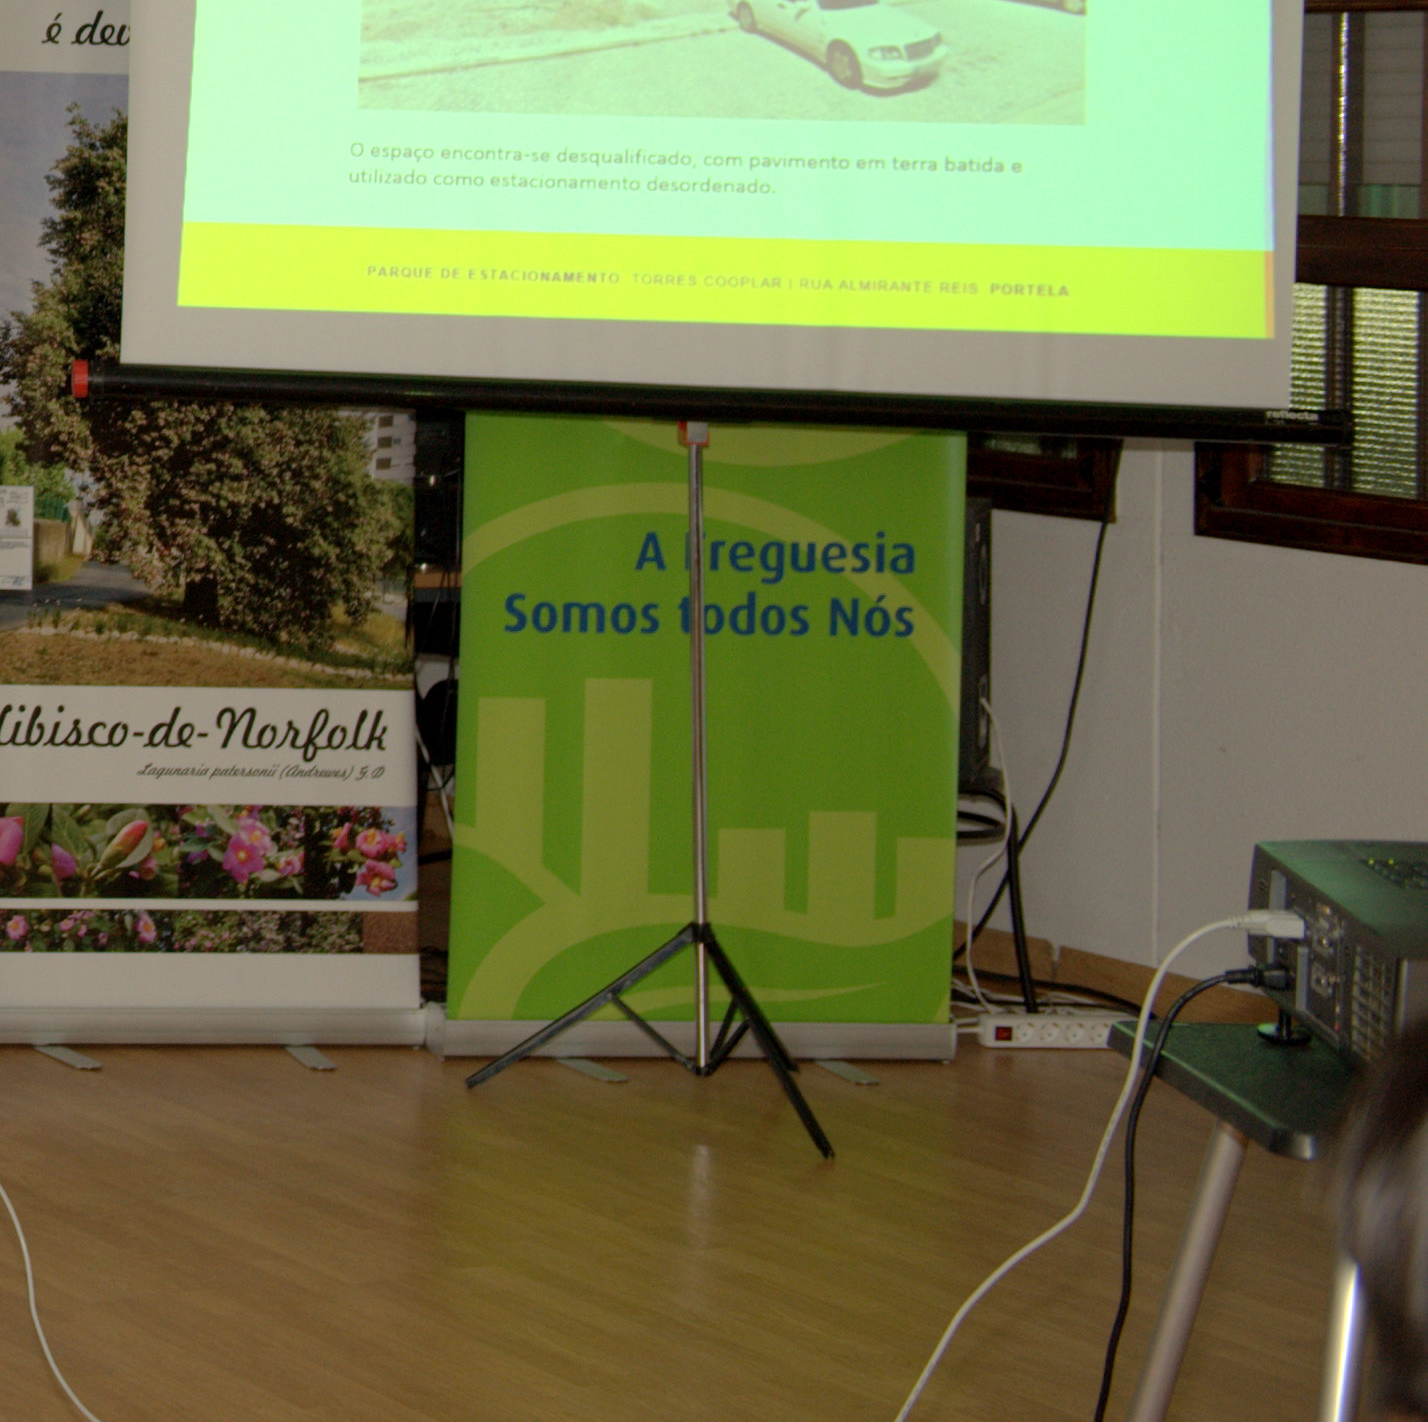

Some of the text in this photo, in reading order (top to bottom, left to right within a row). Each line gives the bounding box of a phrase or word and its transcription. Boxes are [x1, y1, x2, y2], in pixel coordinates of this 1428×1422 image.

[41, 12, 62, 45] é
[349, 142, 1024, 175] O espaço encontra-se desqualificado, com pavimento em terra batida e
[348, 168, 777, 195] utilizado como estacionamento desordenado.
[366, 265, 434, 279] PARQUE
[440, 267, 460, 280] DE
[467, 267, 621, 285] ESTACIONAMENTO
[631, 273, 698, 287] TORRES
[703, 275, 783, 290] COOPLAR
[799, 278, 834, 291] RUA
[838, 279, 934, 294] ALMIRANTE
[939, 281, 980, 295] REIS
[988, 283, 1071, 298] PORTELA
[635, 531, 666, 570] A
[504, 592, 915, 638] Somos todos Nós
[137, 762, 208, 780] Lagunaria
[208, 763, 279, 780] patersonii
